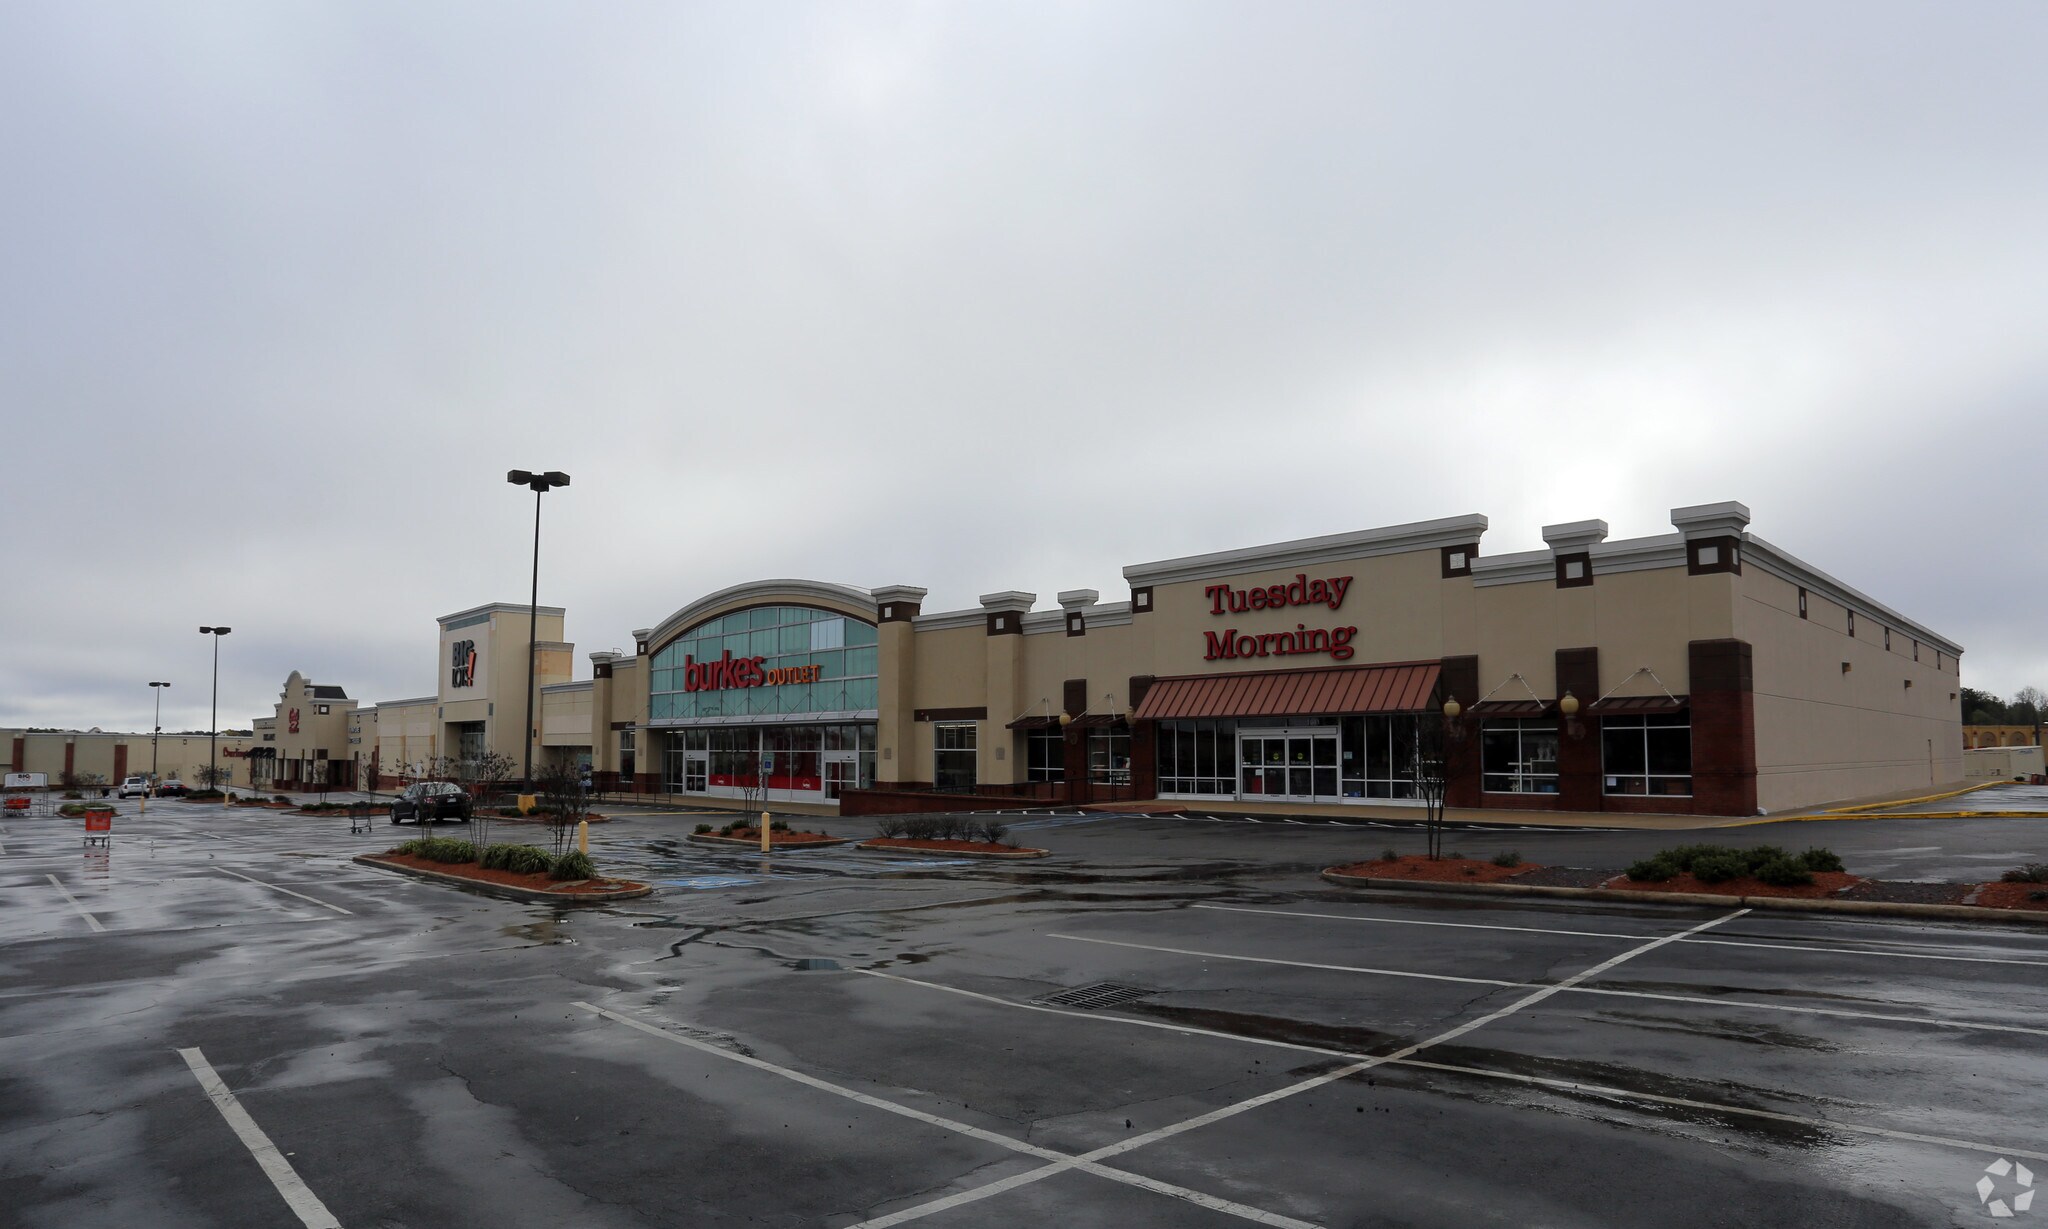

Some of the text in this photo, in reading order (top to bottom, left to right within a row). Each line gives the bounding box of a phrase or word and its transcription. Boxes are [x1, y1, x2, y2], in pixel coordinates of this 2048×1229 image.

[1205, 573, 1353, 615] Tuesday
[453, 639, 474, 667] BIG
[1203, 624, 1357, 660] Morning
[685, 650, 821, 692] burkes OUTLET
